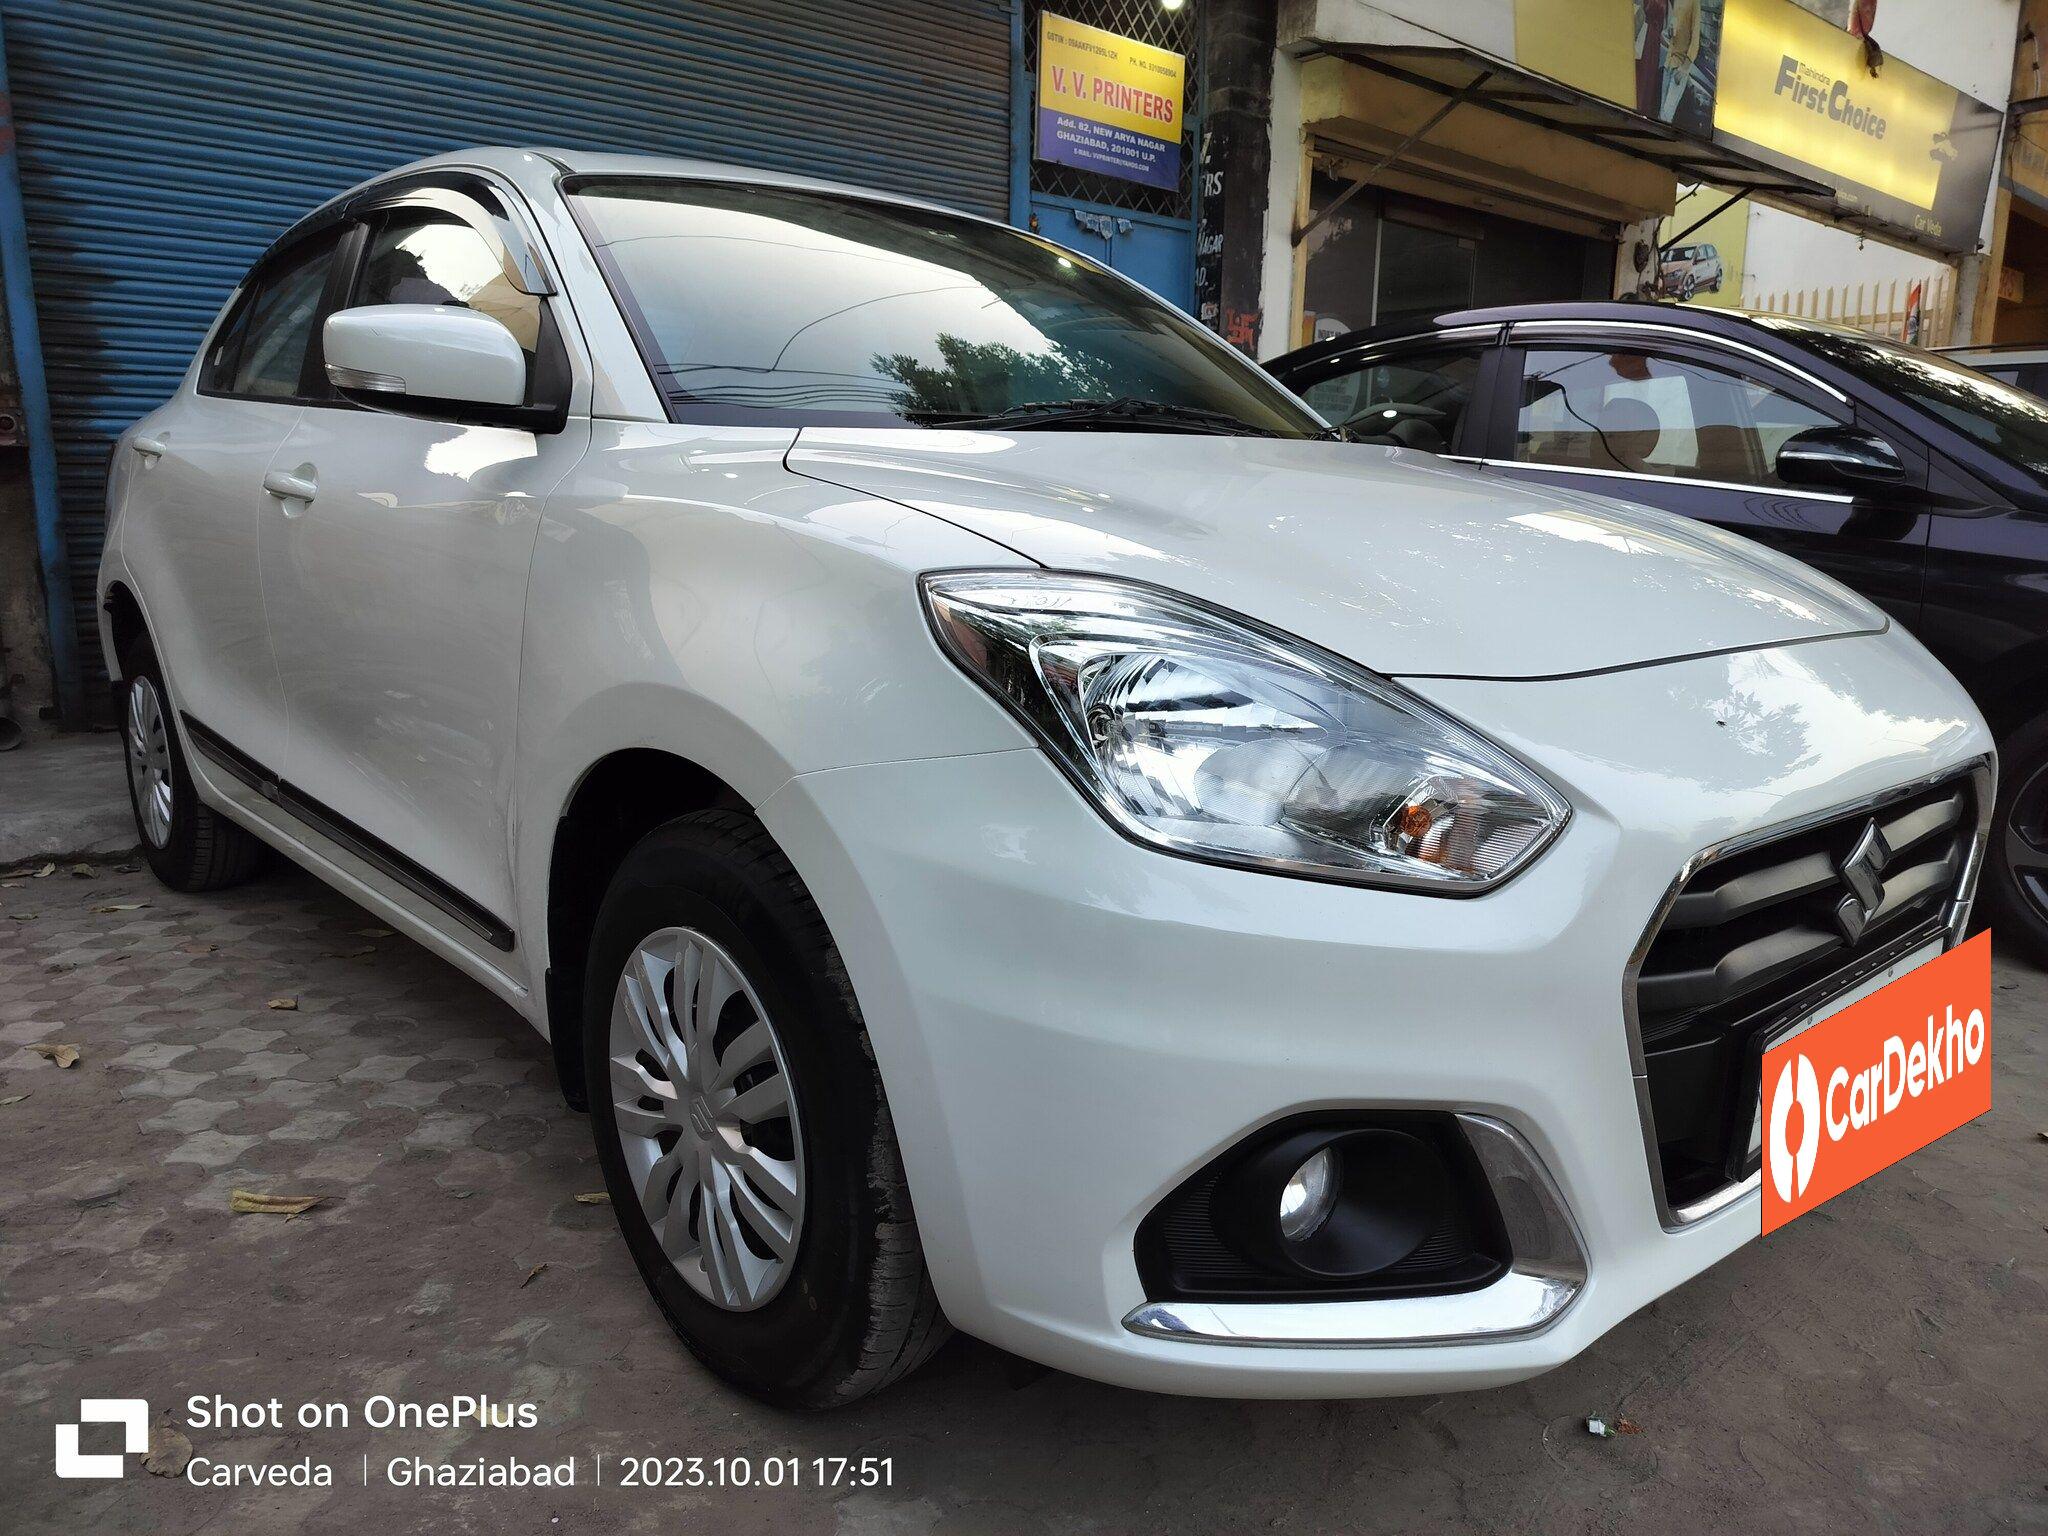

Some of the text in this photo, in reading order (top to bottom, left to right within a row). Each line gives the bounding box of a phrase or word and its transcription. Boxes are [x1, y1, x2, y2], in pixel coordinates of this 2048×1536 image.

[1052, 65, 1173, 124] V. V. PRINTERS
[1056, 130, 1156, 163] GHAZIABAD, 201001 U.P.
[1057, 116, 1166, 152] Add. 82, NEW ARYA NAGAR
